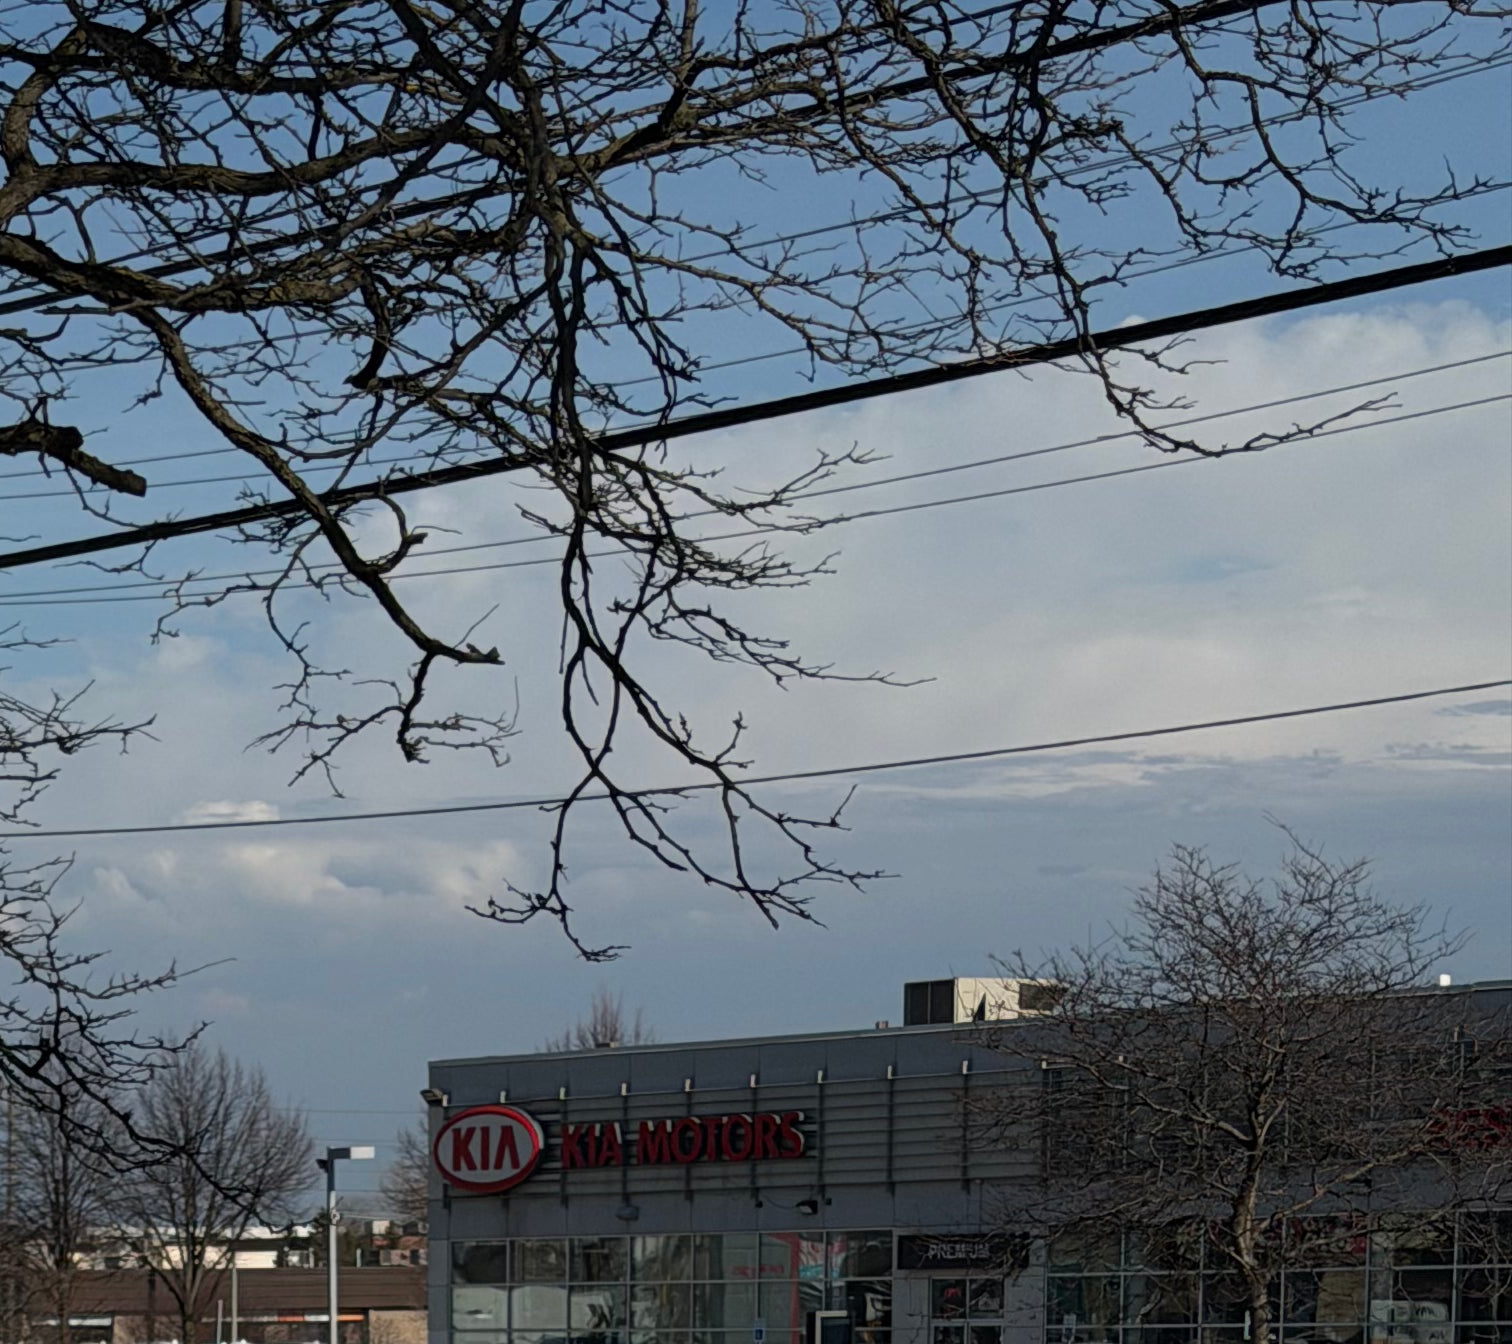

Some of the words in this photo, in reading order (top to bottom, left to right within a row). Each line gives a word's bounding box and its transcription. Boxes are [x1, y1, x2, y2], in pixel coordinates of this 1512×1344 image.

[451, 1125, 521, 1172] KIA
[561, 1122, 624, 1170] KIA
[636, 1111, 805, 1167] MOTORS
